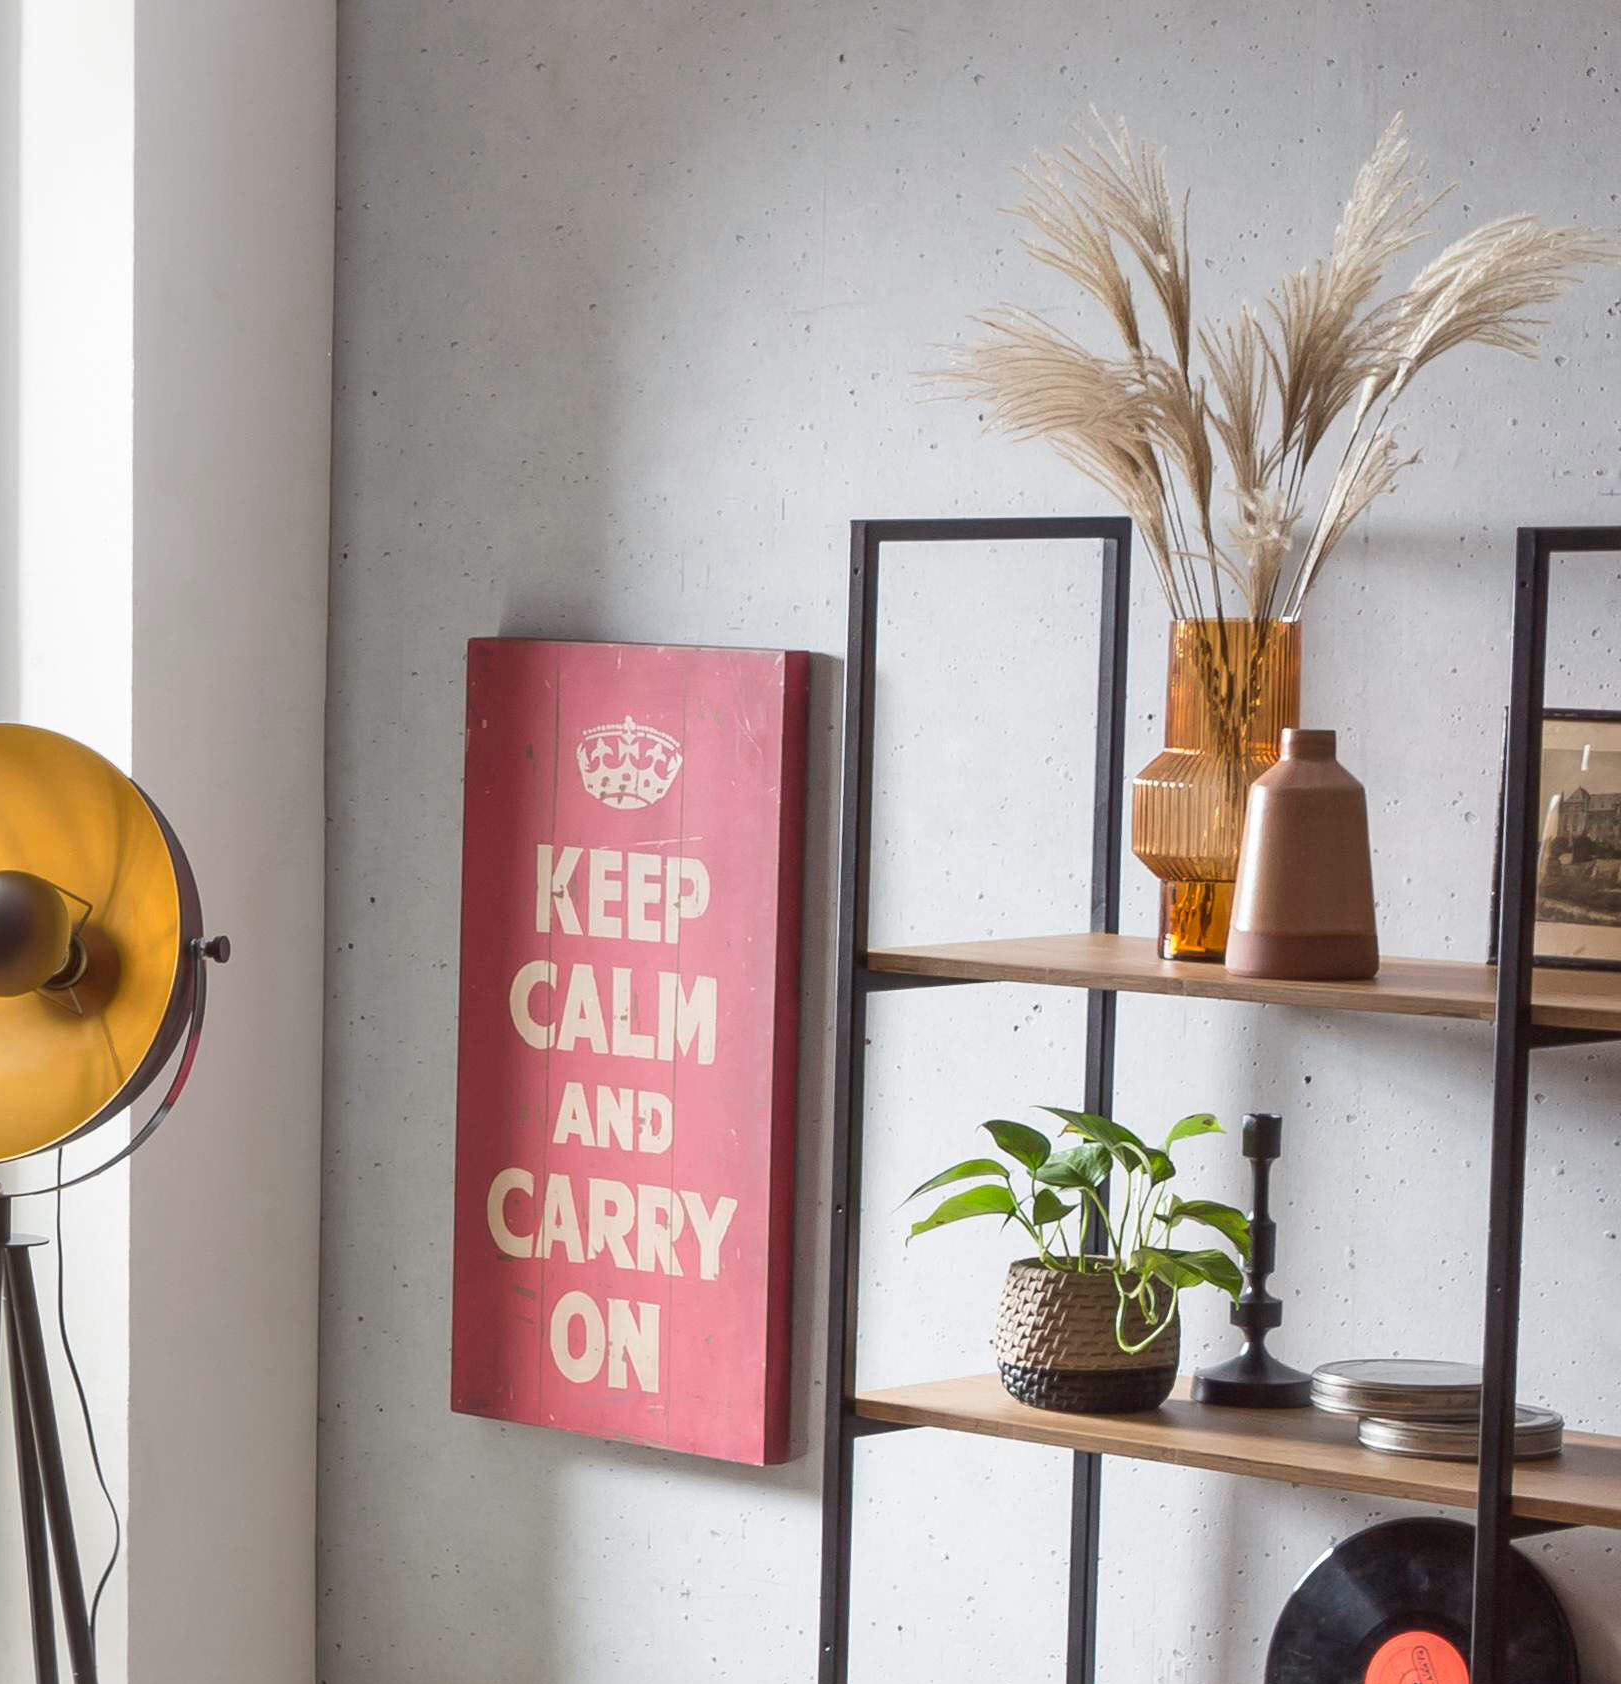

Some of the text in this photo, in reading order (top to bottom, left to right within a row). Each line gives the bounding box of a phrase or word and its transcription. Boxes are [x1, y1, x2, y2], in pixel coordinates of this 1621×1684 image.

[535, 843, 712, 945] KEEP
[508, 960, 718, 1067] CALM
[552, 1081, 674, 1156] AND
[485, 1168, 738, 1281] CARRY
[550, 1290, 661, 1394] ON
